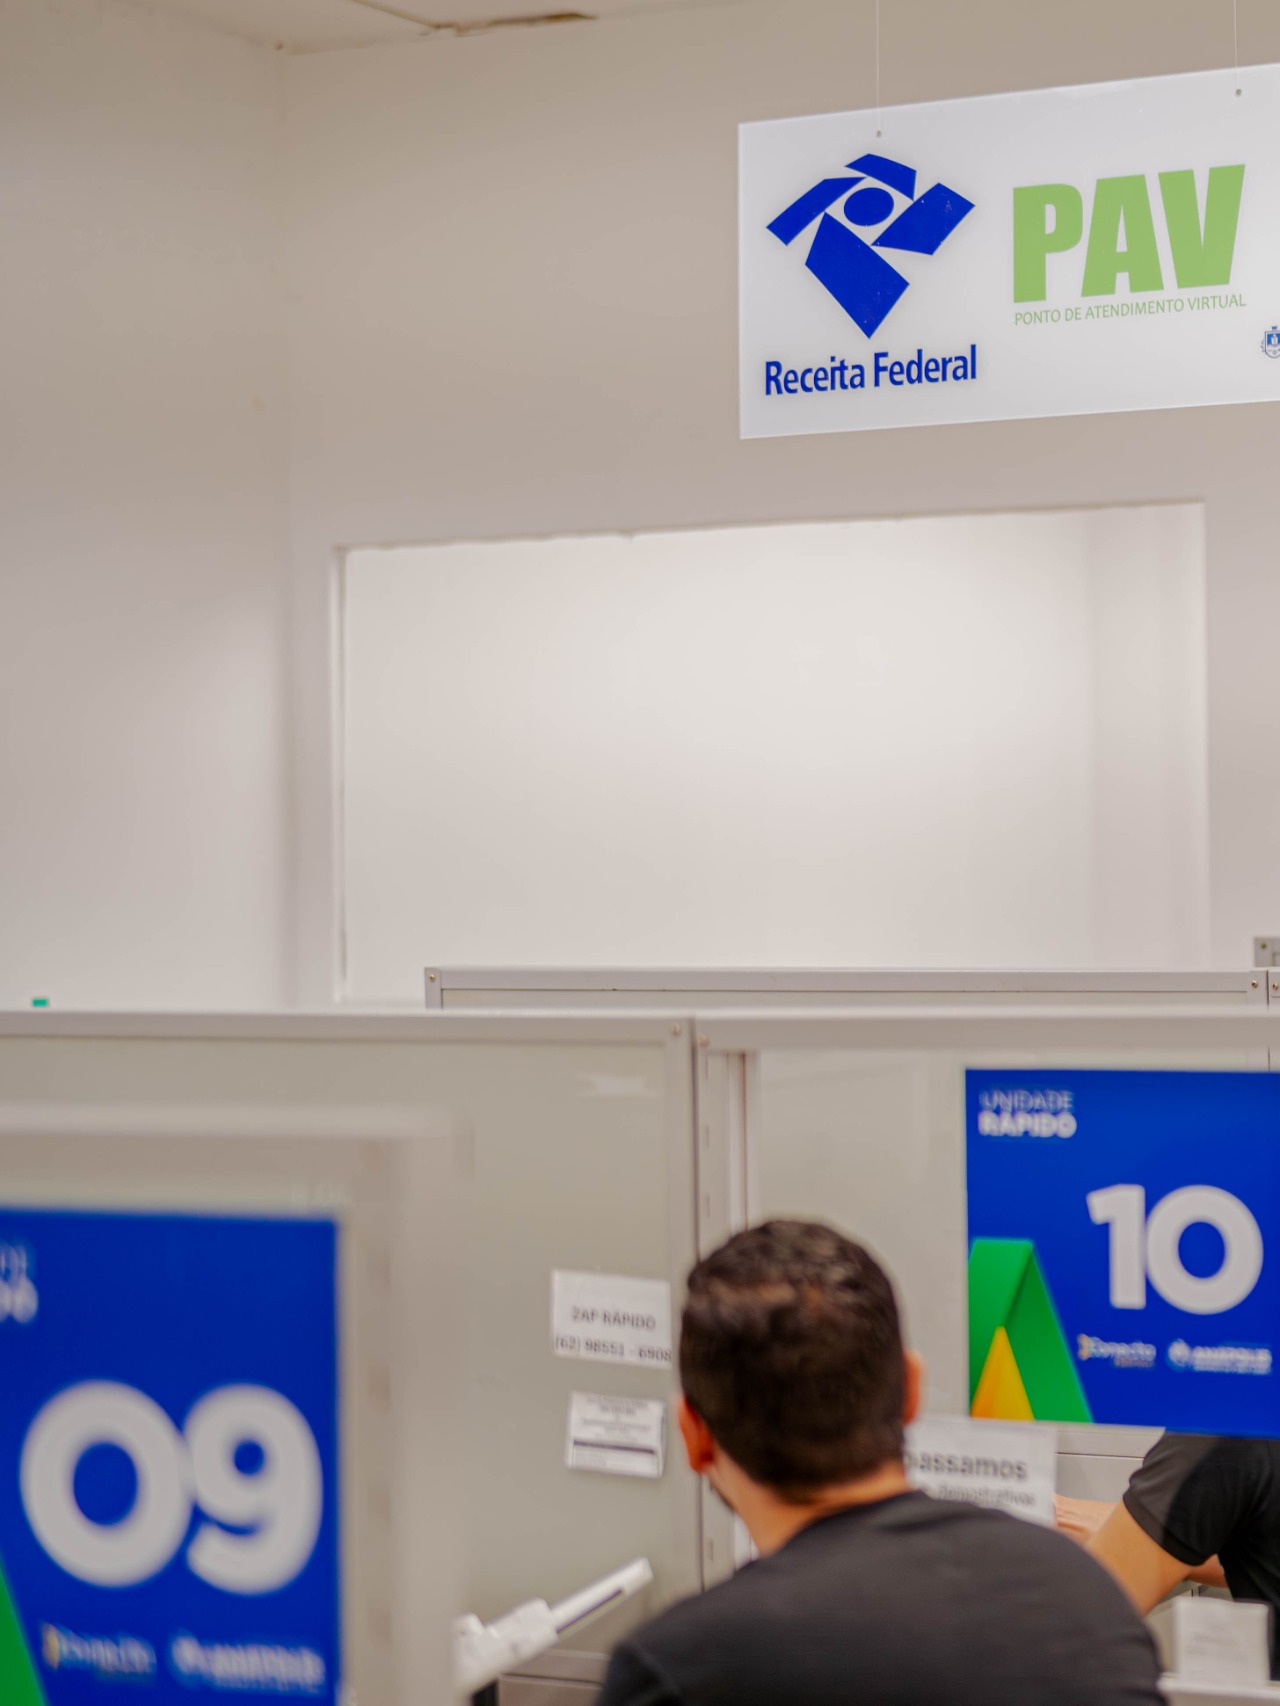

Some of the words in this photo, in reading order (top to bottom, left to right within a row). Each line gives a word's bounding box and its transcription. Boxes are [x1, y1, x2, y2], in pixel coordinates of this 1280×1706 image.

[1013, 164, 1246, 303] PAV
[1014, 308, 1061, 326] PONTO
[1065, 306, 1082, 321] DE
[1085, 298, 1184, 320] ATENDIMENTO
[1187, 293, 1247, 311] VIRTUAL
[765, 351, 865, 397] Receita
[873, 344, 977, 389] Federal
[978, 1111, 1077, 1138] RÁPIDO
[979, 1089, 1075, 1111] UNIDADE
[1086, 1183, 1264, 1315] 10
[19, 1378, 324, 1597] 09
